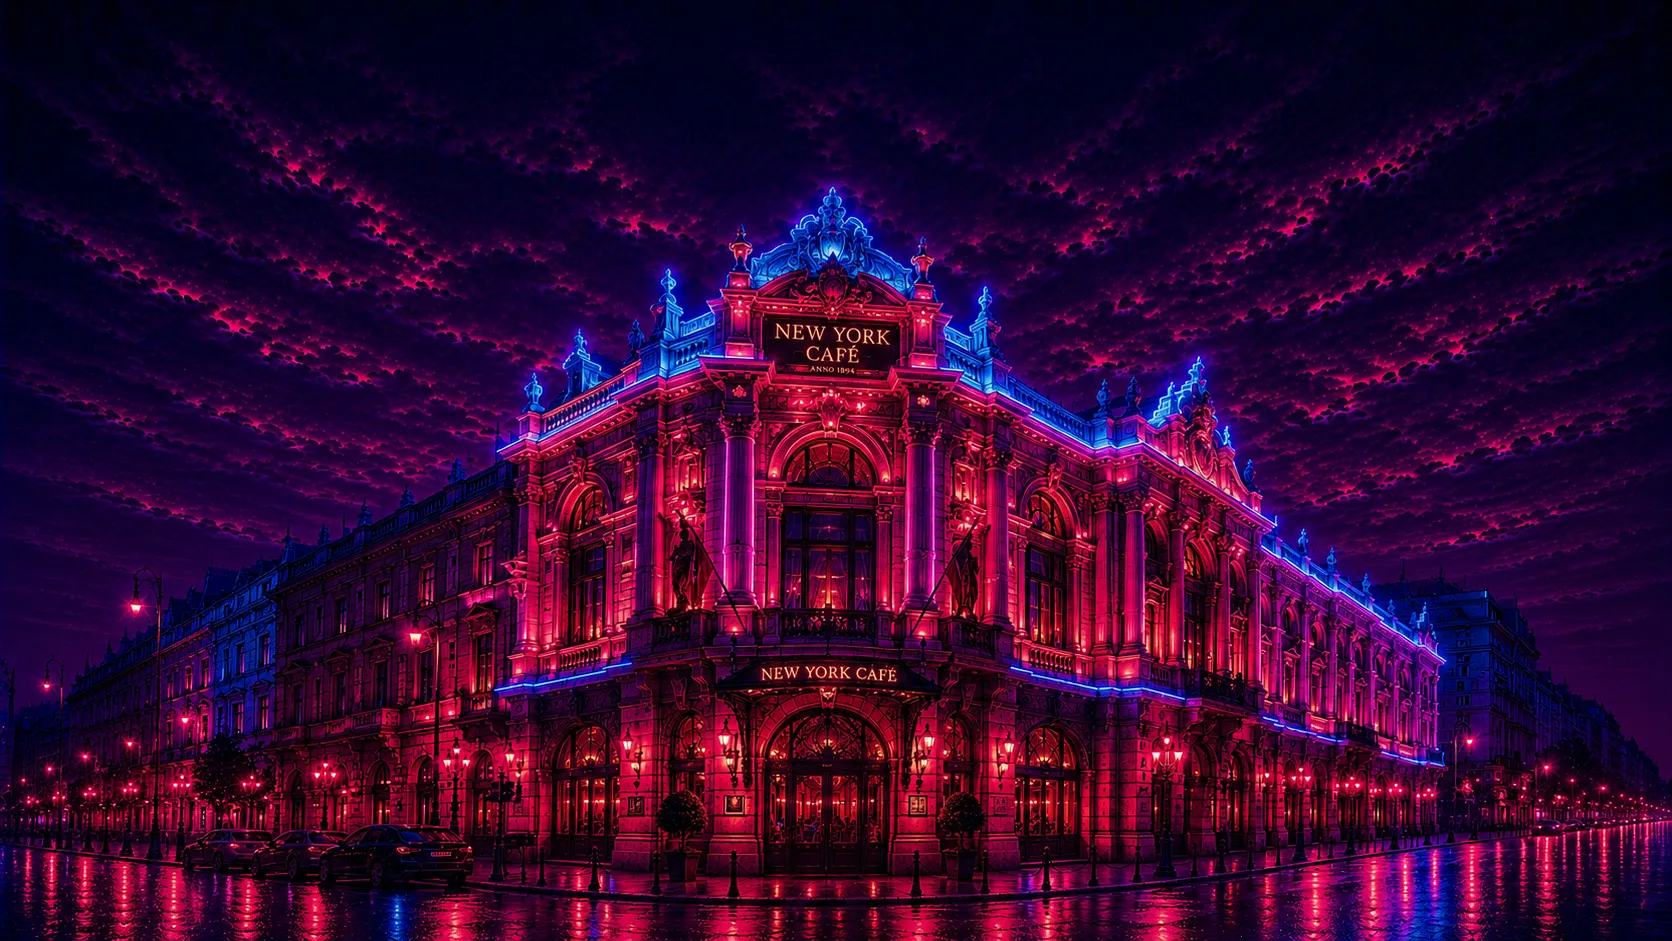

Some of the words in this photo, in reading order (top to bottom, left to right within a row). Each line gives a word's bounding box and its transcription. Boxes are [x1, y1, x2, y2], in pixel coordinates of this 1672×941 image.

[775, 323, 825, 341] NEW
[833, 327, 891, 346] YORK
[806, 345, 860, 363] CAFÉ
[761, 666, 800, 681] NEW
[805, 666, 851, 680] YORK
[856, 667, 897, 682] CAFÉ
